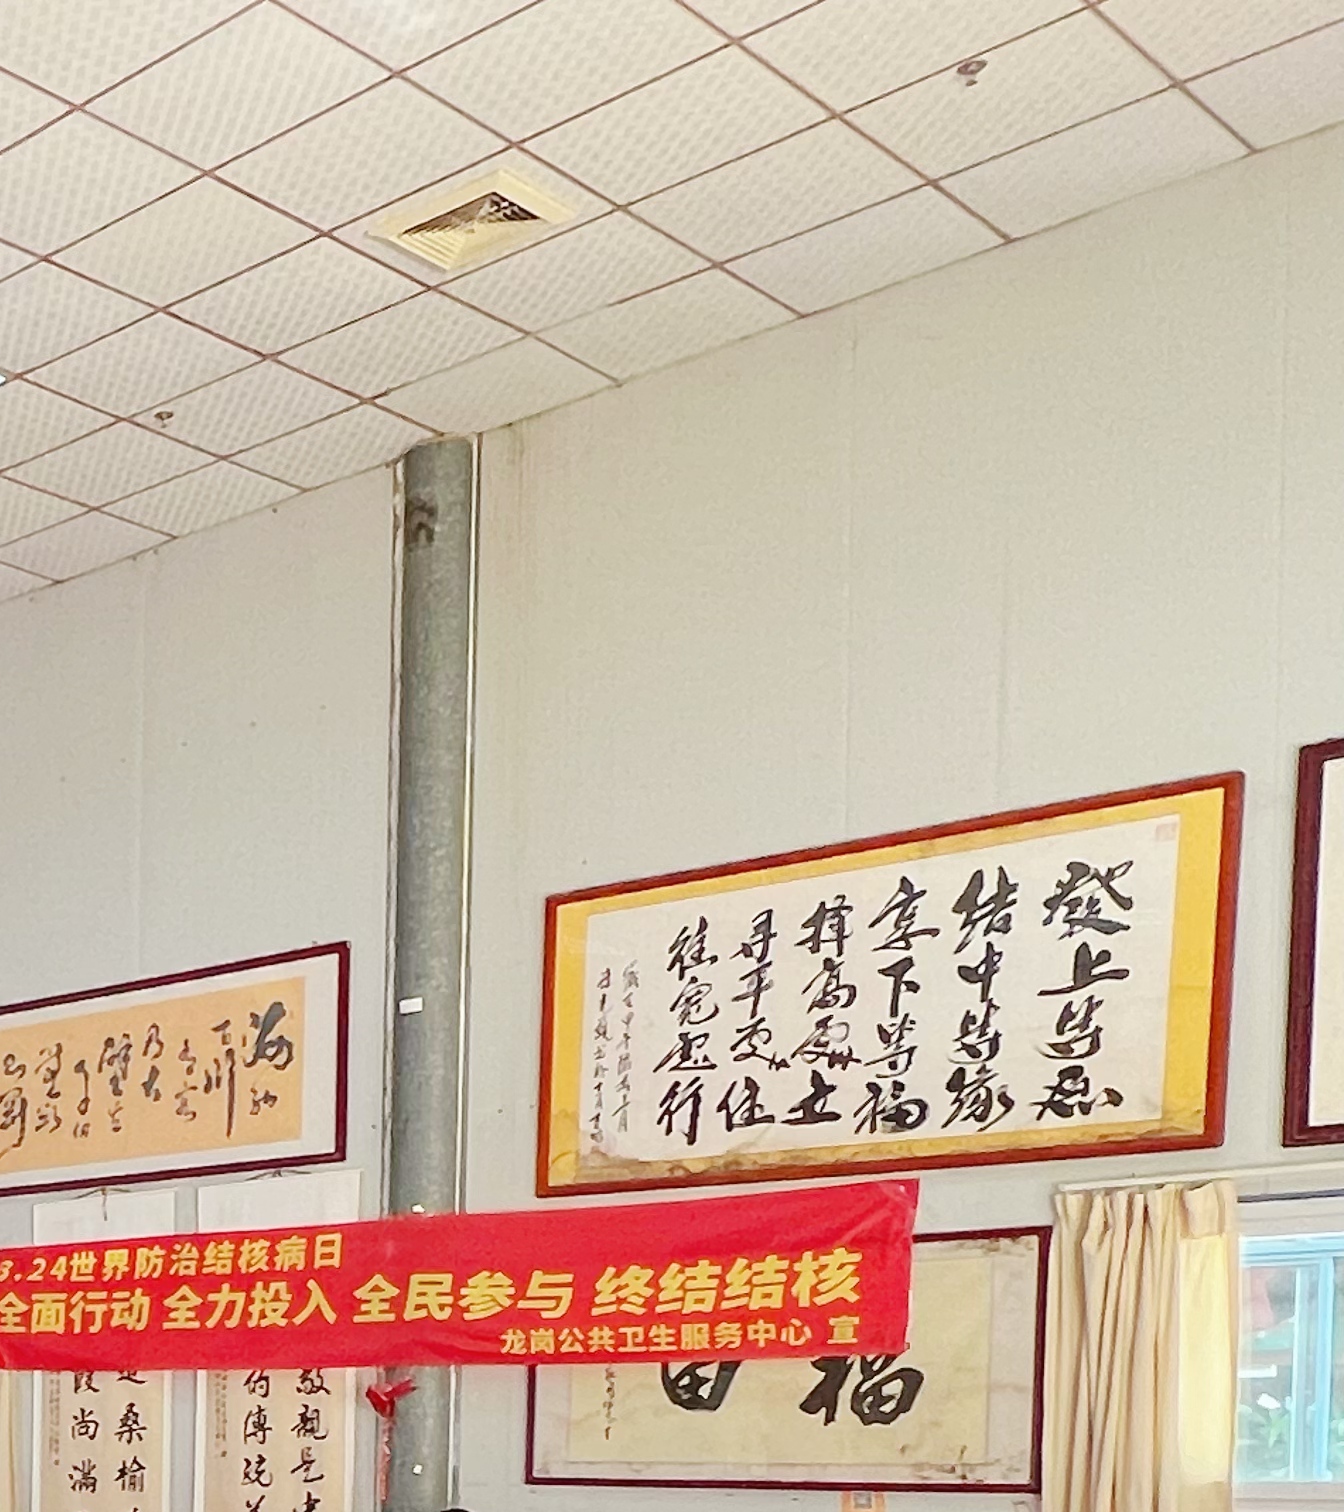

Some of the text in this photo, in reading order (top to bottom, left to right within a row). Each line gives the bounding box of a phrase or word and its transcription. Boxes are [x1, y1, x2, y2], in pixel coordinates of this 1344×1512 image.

[162, 1279, 337, 1330] 全力投入
[353, 1269, 574, 1325] 全民参与
[591, 1246, 863, 1317] 终结结核
[500, 1315, 860, 1355] 龙岗公共卫生服务中心 宣
